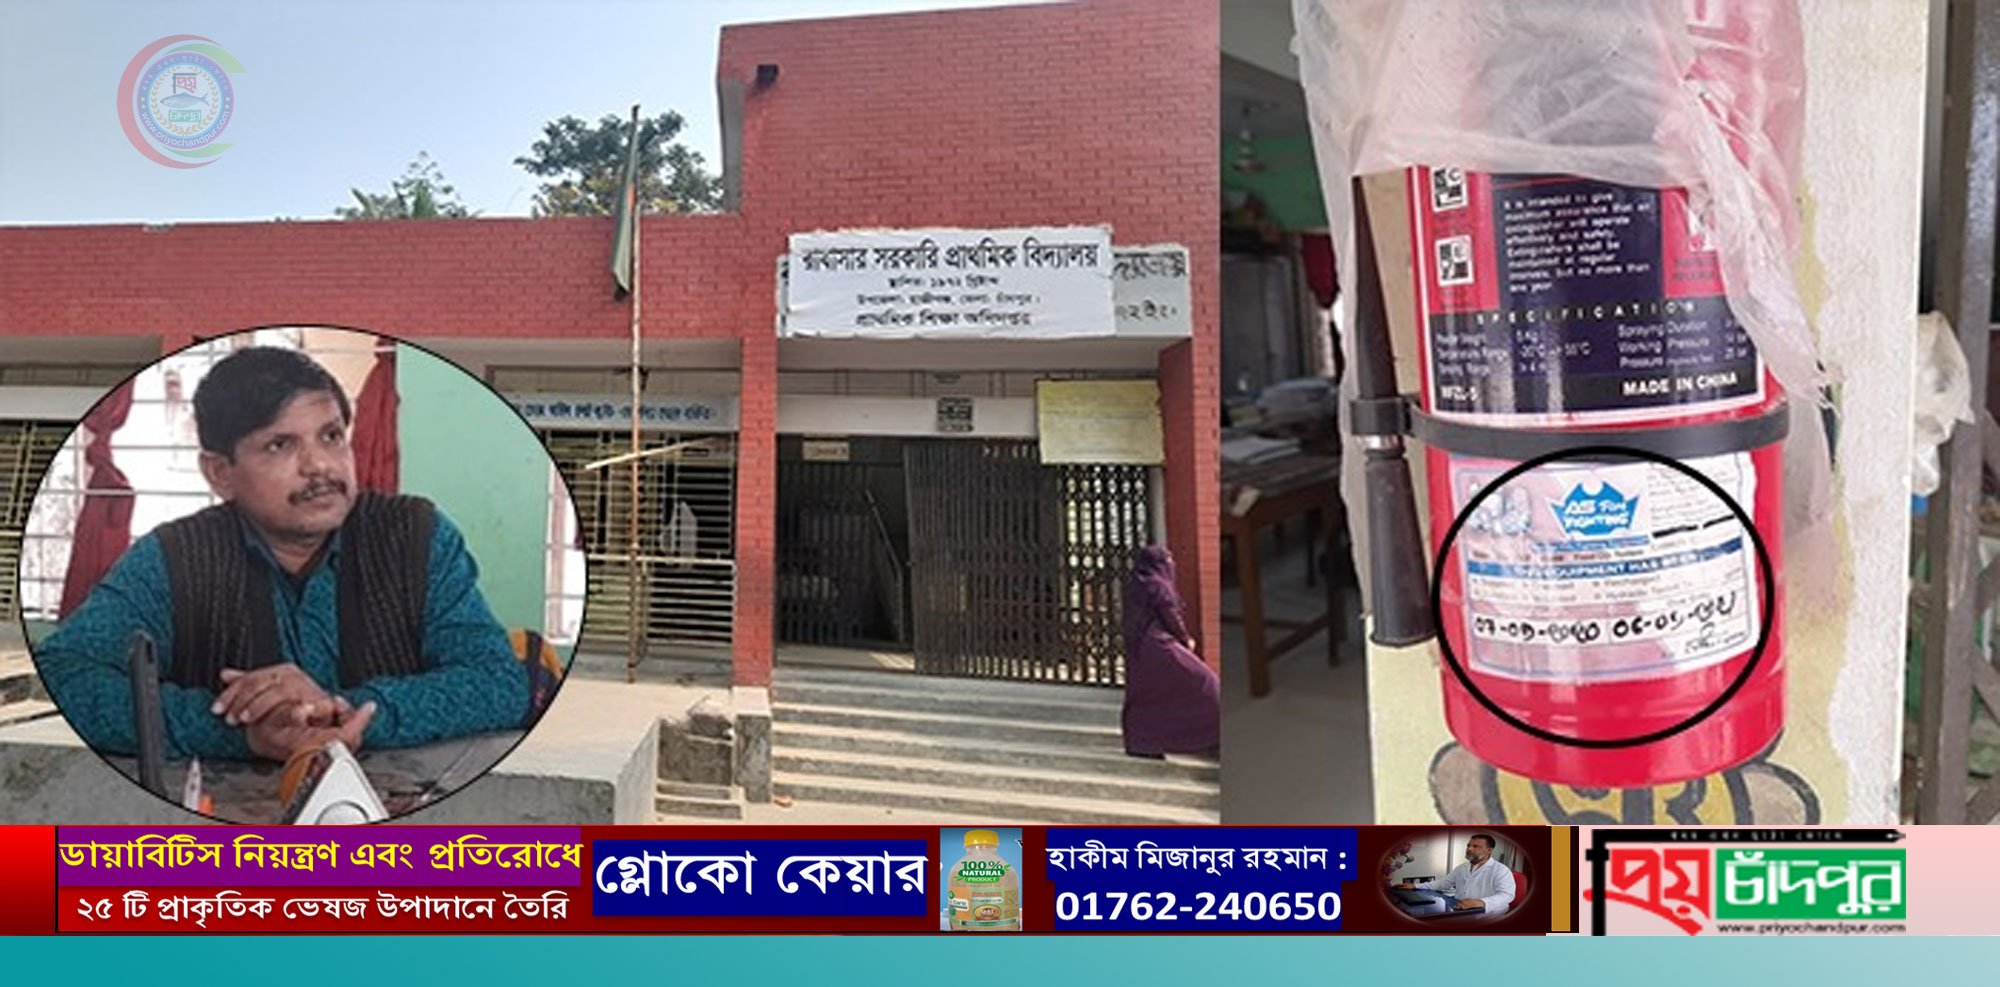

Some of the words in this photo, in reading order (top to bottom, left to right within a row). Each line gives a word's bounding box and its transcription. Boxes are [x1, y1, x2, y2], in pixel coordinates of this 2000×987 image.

[873, 239, 940, 270] সরকারি
[944, 237, 1018, 269] প্রাথমিক
[1023, 237, 1099, 269] বিদ্যালয়
[1596, 265, 1623, 275] more
[1622, 379, 1670, 396] MADE
[1676, 377, 1694, 391] IN
[1697, 371, 1738, 390] CHINA
[961, 861, 1003, 870] 100%
[962, 869, 1003, 877] NATURAL
